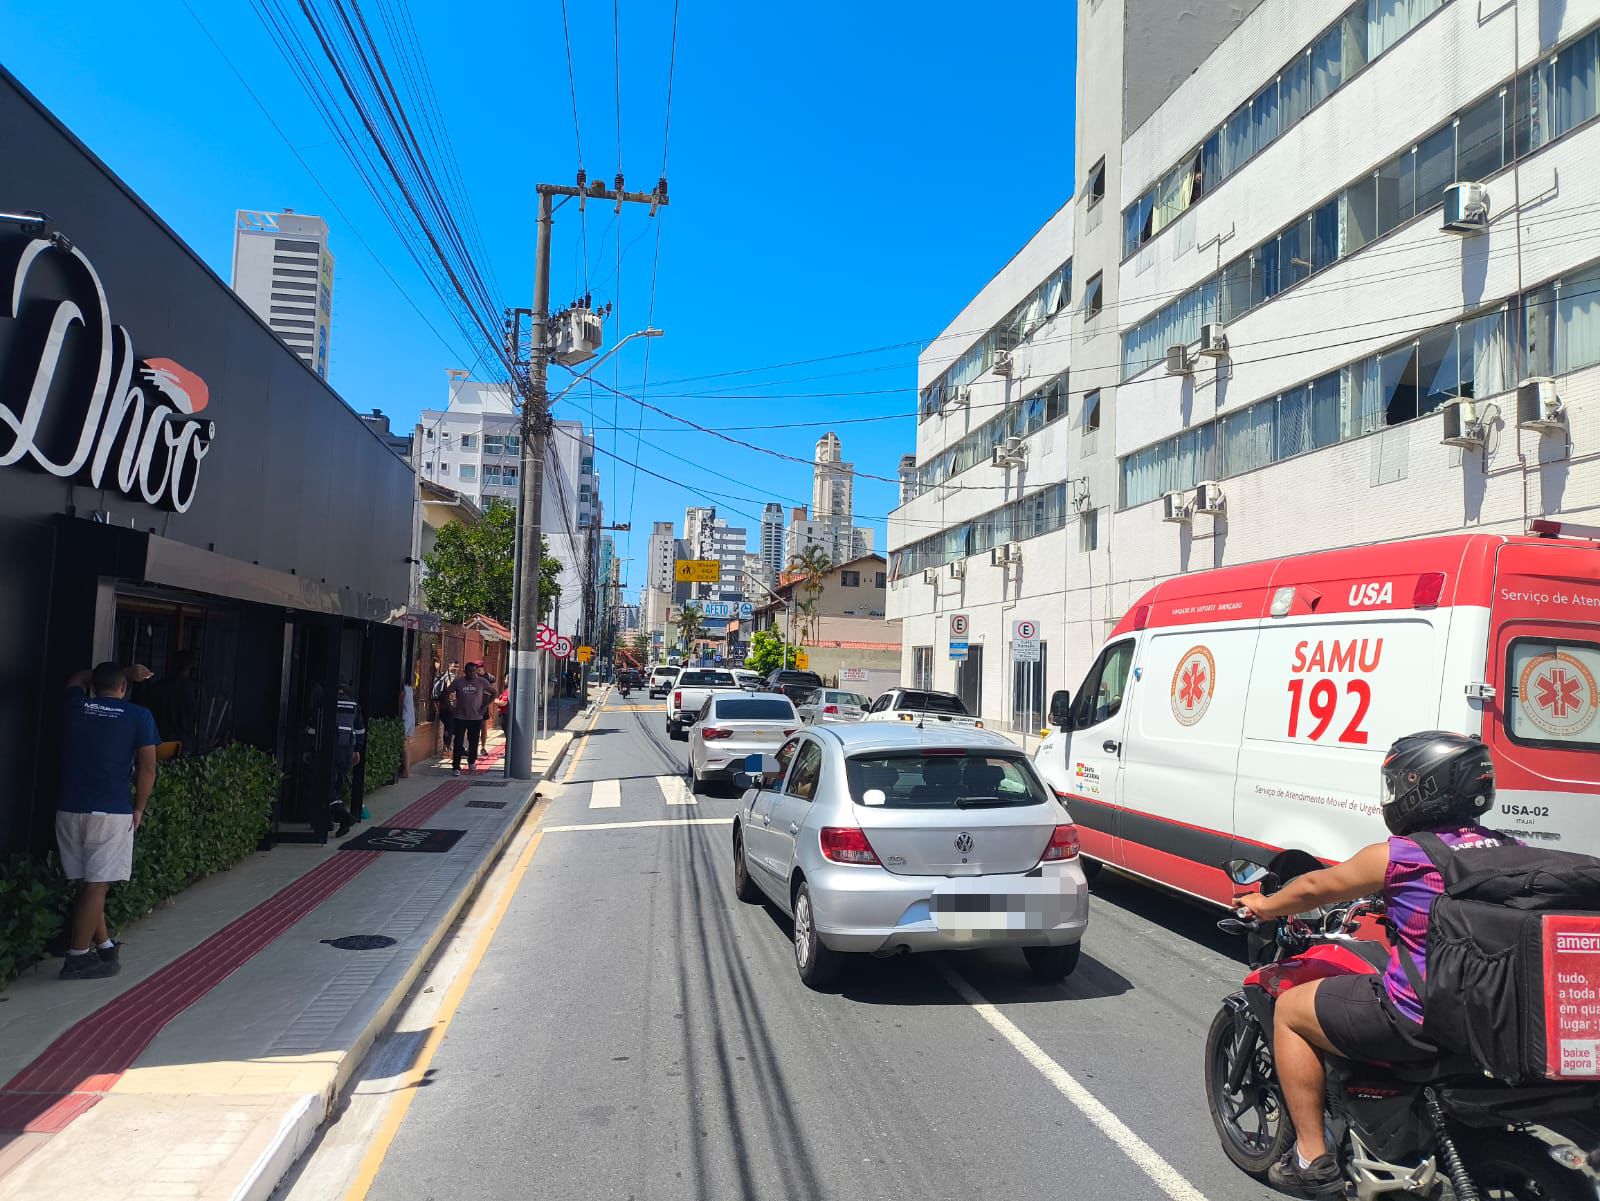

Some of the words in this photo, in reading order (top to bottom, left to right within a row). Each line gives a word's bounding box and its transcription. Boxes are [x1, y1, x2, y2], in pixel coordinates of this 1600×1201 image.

[1348, 582, 1393, 606] USA
[1501, 588, 1549, 605] Serviço
[1552, 592, 1568, 604] de
[705, 604, 728, 615] AFETO
[956, 620, 962, 630] E
[1023, 625, 1030, 635] E
[1291, 637, 1384, 673] SAMU
[1287, 678, 1371, 745] 192
[1254, 784, 1275, 798] Serviço
[1276, 788, 1284, 798] de
[1285, 790, 1326, 805] Atendimento
[1348, 800, 1358, 811] de
[1501, 804, 1549, 817] USA-02
[1557, 972, 1589, 986] tudo,
[1559, 989, 1566, 999] a
[1568, 987, 1595, 999] toda
[1559, 1005, 1578, 1015] em
[1560, 1018, 1591, 1032] lugar
[1563, 1047, 1590, 1058] baixe
[1563, 1059, 1592, 1071] agora
